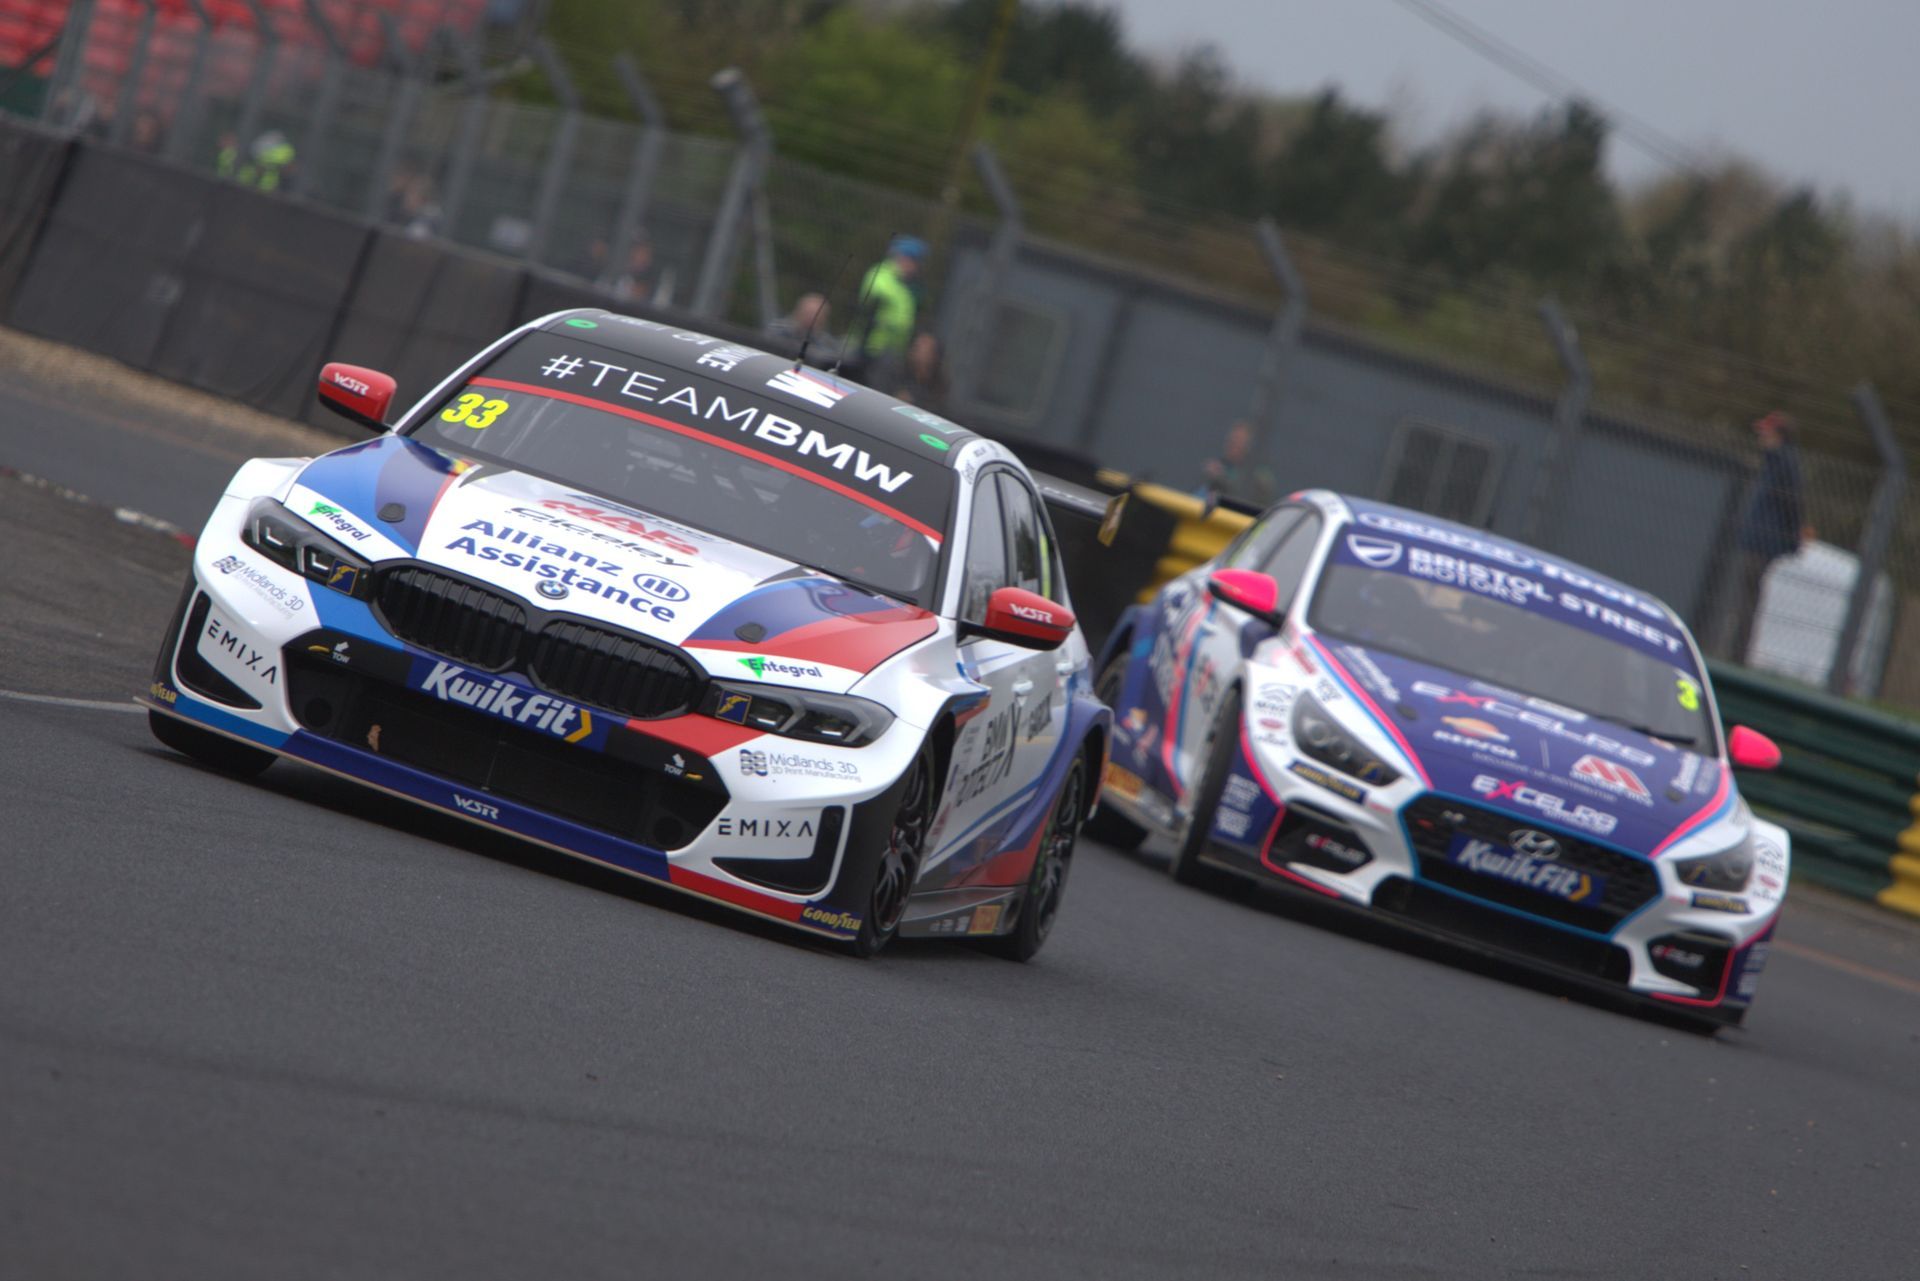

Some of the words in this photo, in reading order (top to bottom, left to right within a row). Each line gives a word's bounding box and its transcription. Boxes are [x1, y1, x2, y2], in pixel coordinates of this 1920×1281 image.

[334, 372, 370, 396] WSR
[441, 393, 509, 429] 33
[541, 353, 914, 494] #TEAMBMW
[315, 504, 372, 541] Entegral
[461, 518, 624, 577] Allianz
[240, 566, 287, 601] Midlands
[285, 595, 304, 611] 3D
[445, 536, 676, 623] Assistance
[1009, 602, 1053, 624] WSR
[1408, 547, 1553, 602] BRISTOL
[1560, 592, 1683, 652] STREET
[207, 619, 277, 685] EMIXA
[333, 652, 350, 664] TOW
[748, 658, 823, 678] Entegral
[1676, 678, 1700, 712] 3
[664, 763, 682, 776] TOW
[769, 752, 834, 772] Midlands
[837, 760, 858, 774] 3D
[454, 793, 499, 819] WSR
[718, 818, 814, 838] EMIXA
